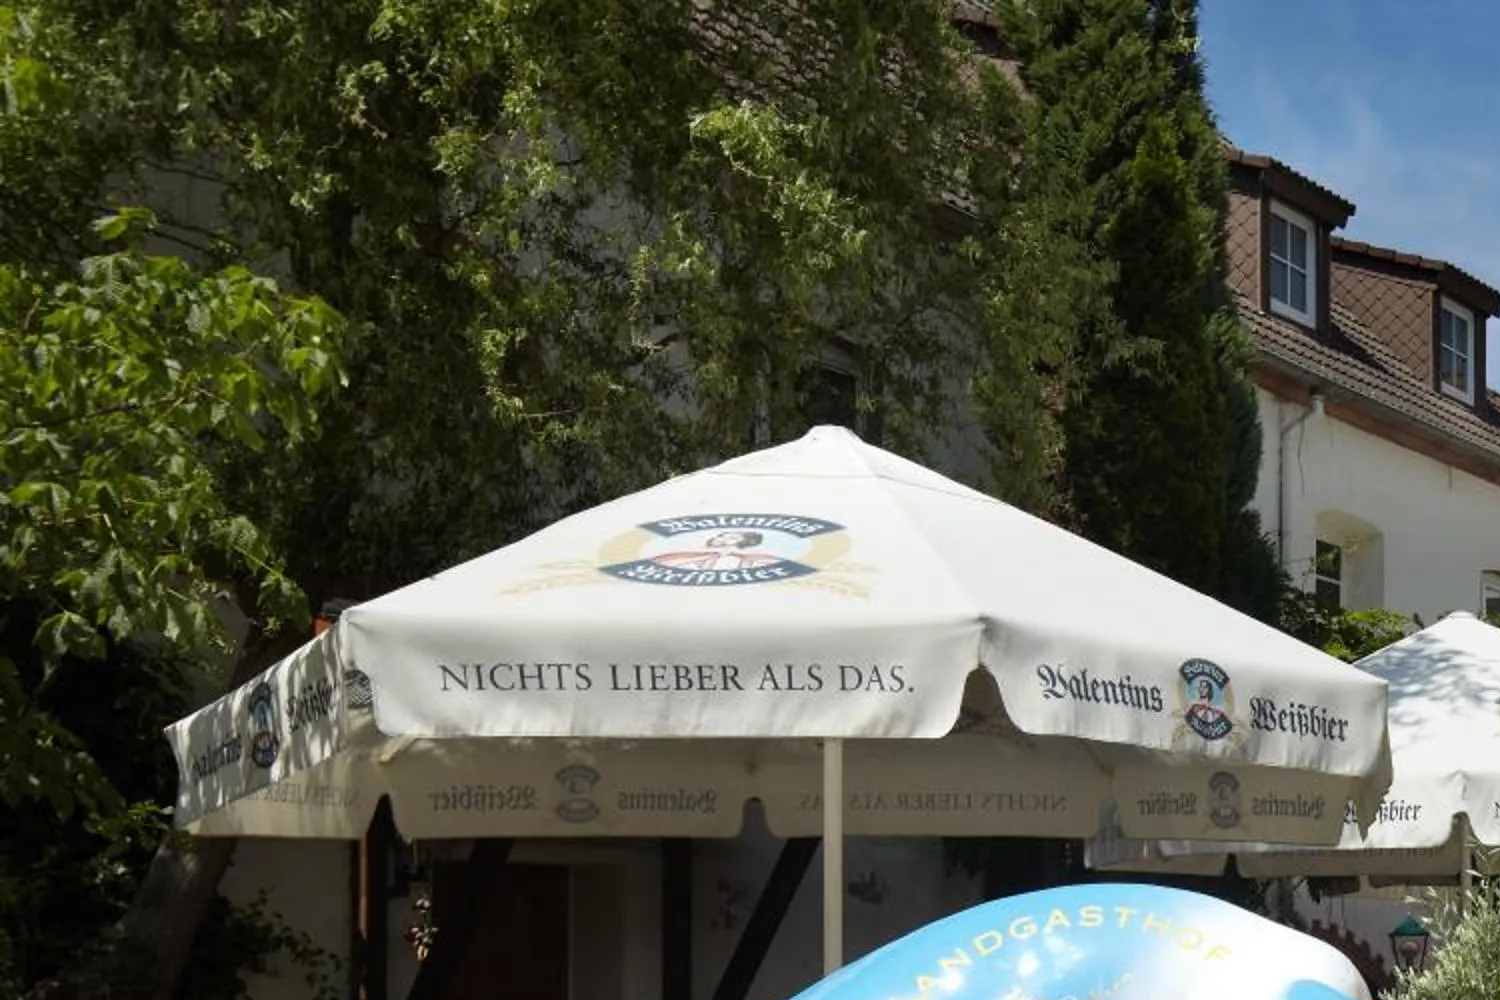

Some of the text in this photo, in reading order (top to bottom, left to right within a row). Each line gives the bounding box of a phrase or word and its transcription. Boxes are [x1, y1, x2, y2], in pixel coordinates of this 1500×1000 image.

[438, 663, 915, 693] NICHTS LIEBER ALS DAS.
[1037, 664, 1163, 712] Valentins
[1250, 696, 1349, 742] Weißbier
